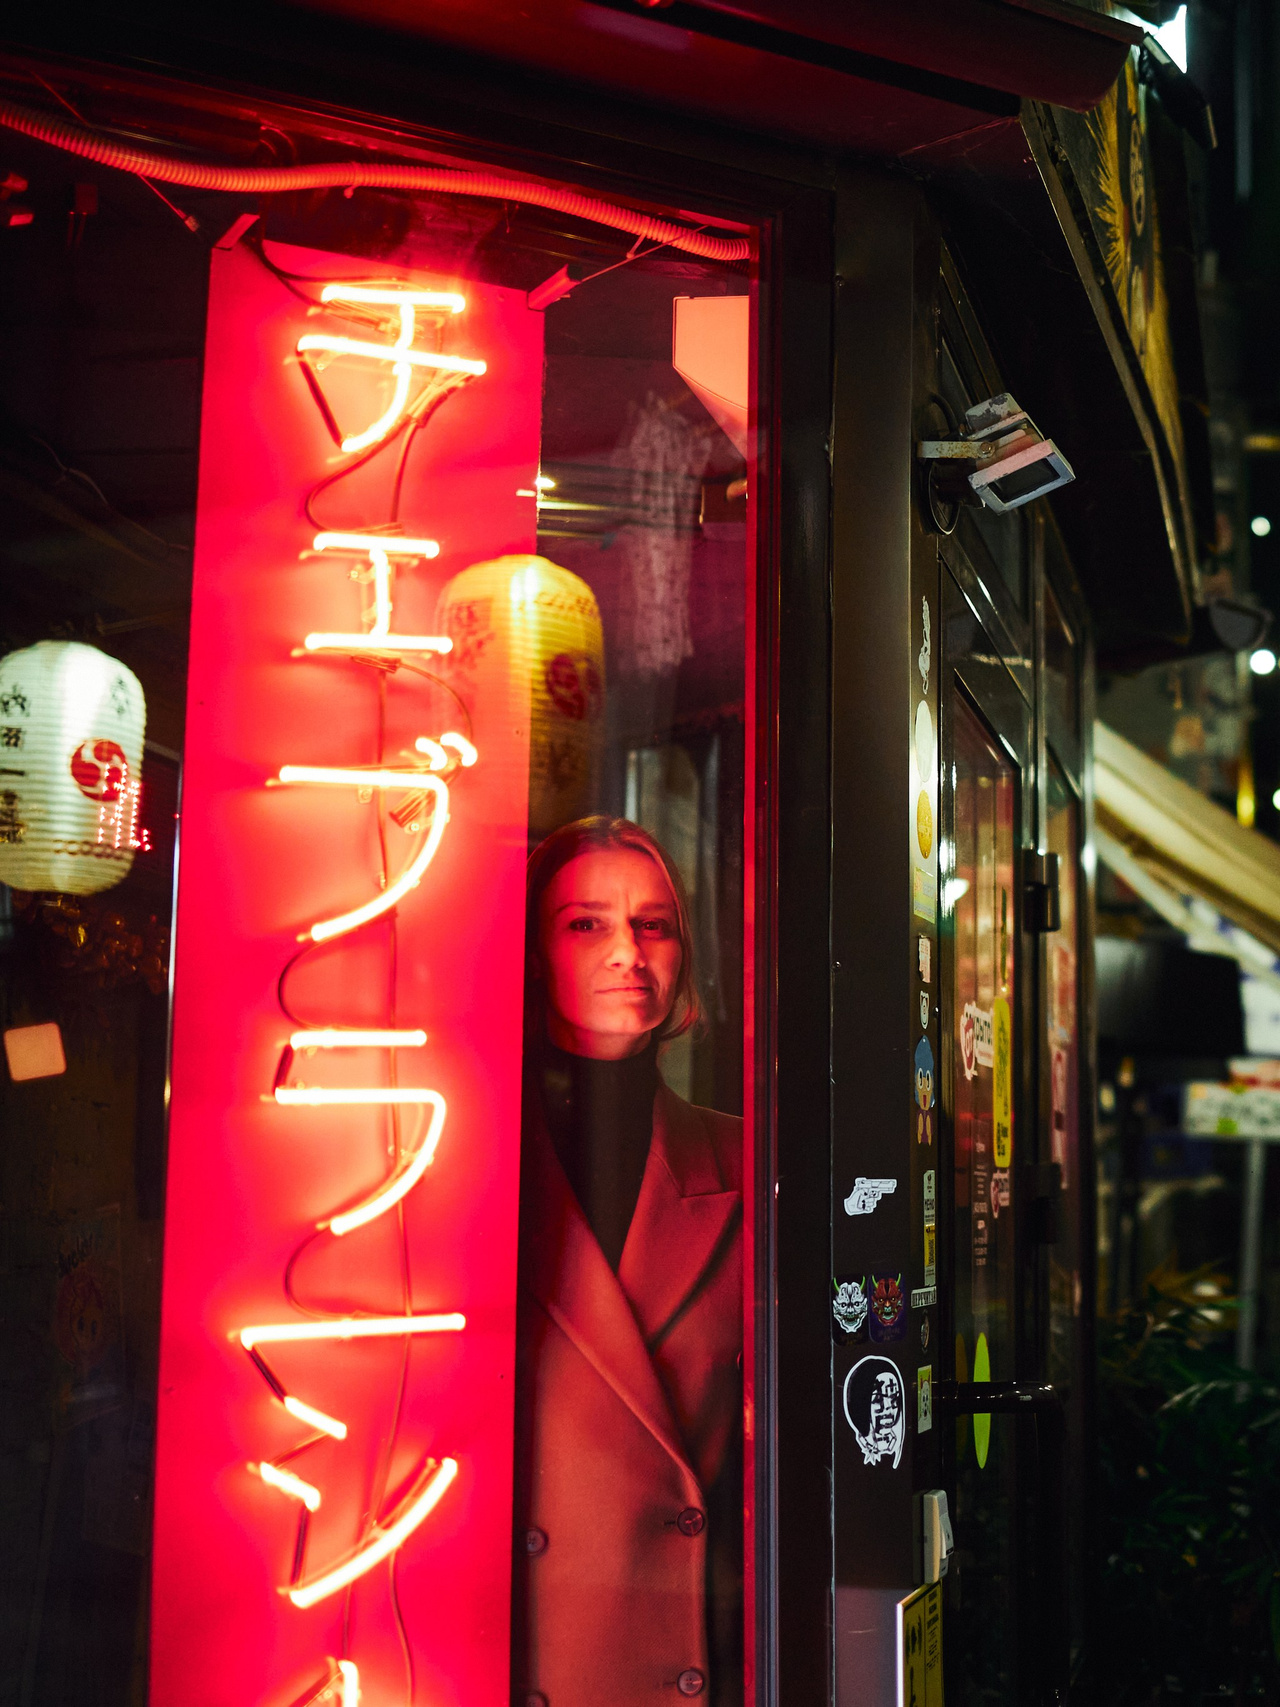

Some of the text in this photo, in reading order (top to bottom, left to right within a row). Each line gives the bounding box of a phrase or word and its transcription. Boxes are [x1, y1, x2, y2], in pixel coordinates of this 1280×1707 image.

[238, 282, 488, 1707] チェブラーシ
